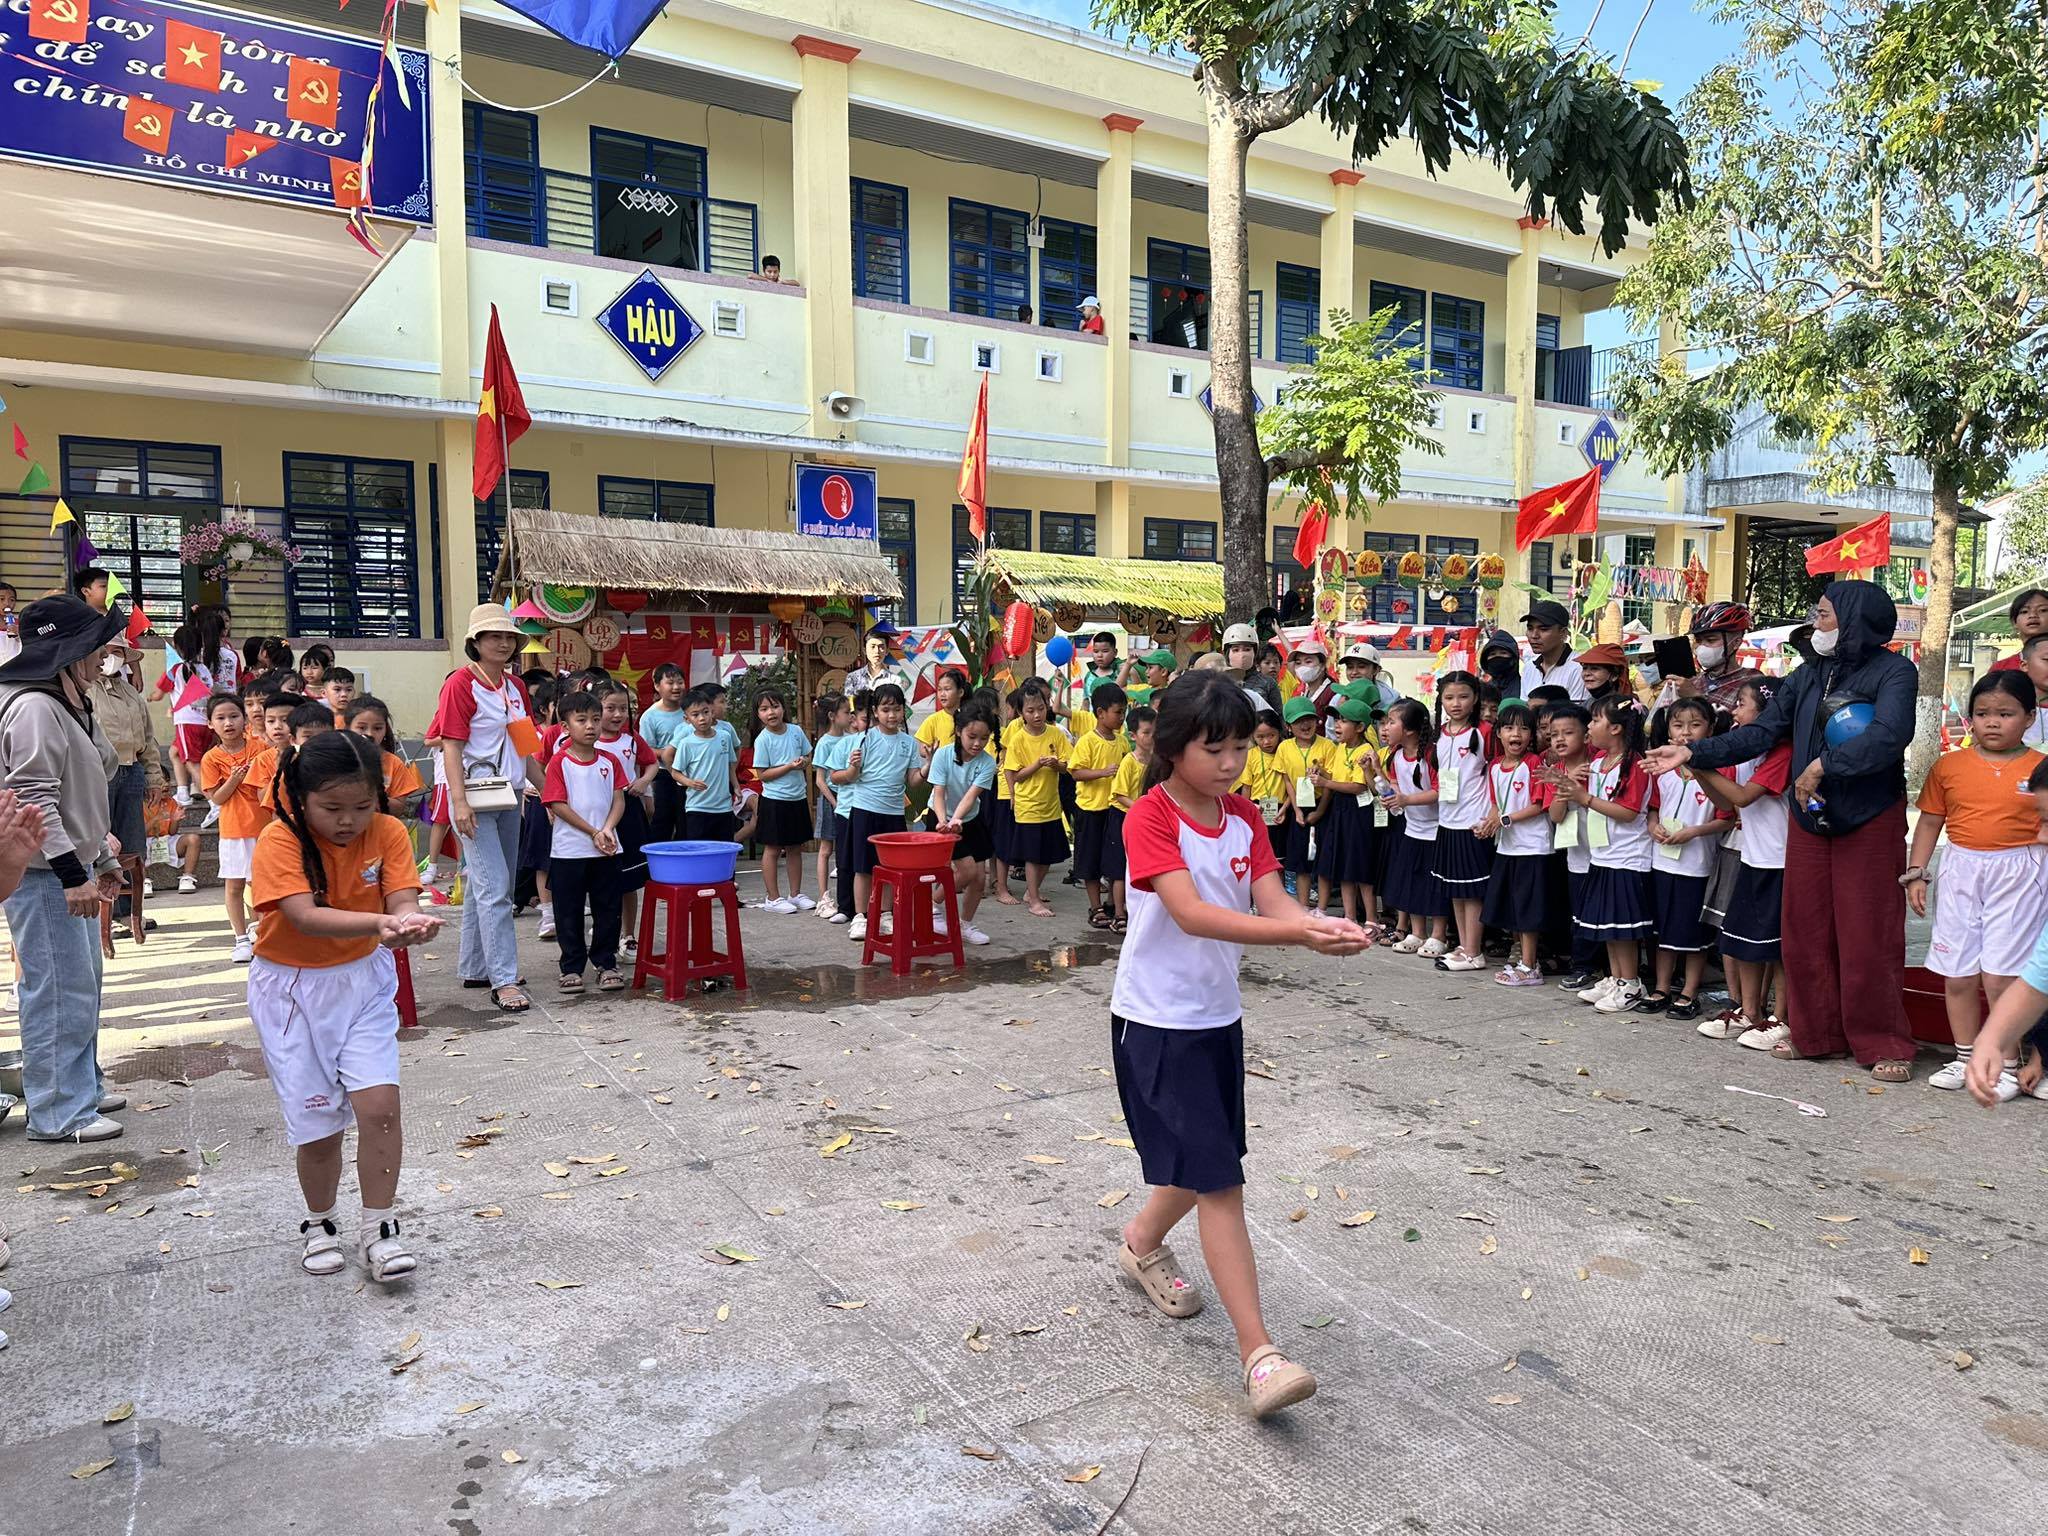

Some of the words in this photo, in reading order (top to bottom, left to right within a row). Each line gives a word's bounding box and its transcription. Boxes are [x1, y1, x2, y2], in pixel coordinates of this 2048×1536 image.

[87, 14, 154, 41] ay
[35, 41, 104, 65] để
[14, 75, 157, 111] chín
[186, 101, 237, 129] là
[254, 119, 347, 147] nhờ
[144, 153, 187, 170] HỒ
[196, 163, 249, 181] CHÍ
[257, 171, 331, 193] MINH
[626, 297, 676, 357] HẬU
[1593, 430, 1615, 461] VĂN
[1155, 618, 1177, 635] 2A
